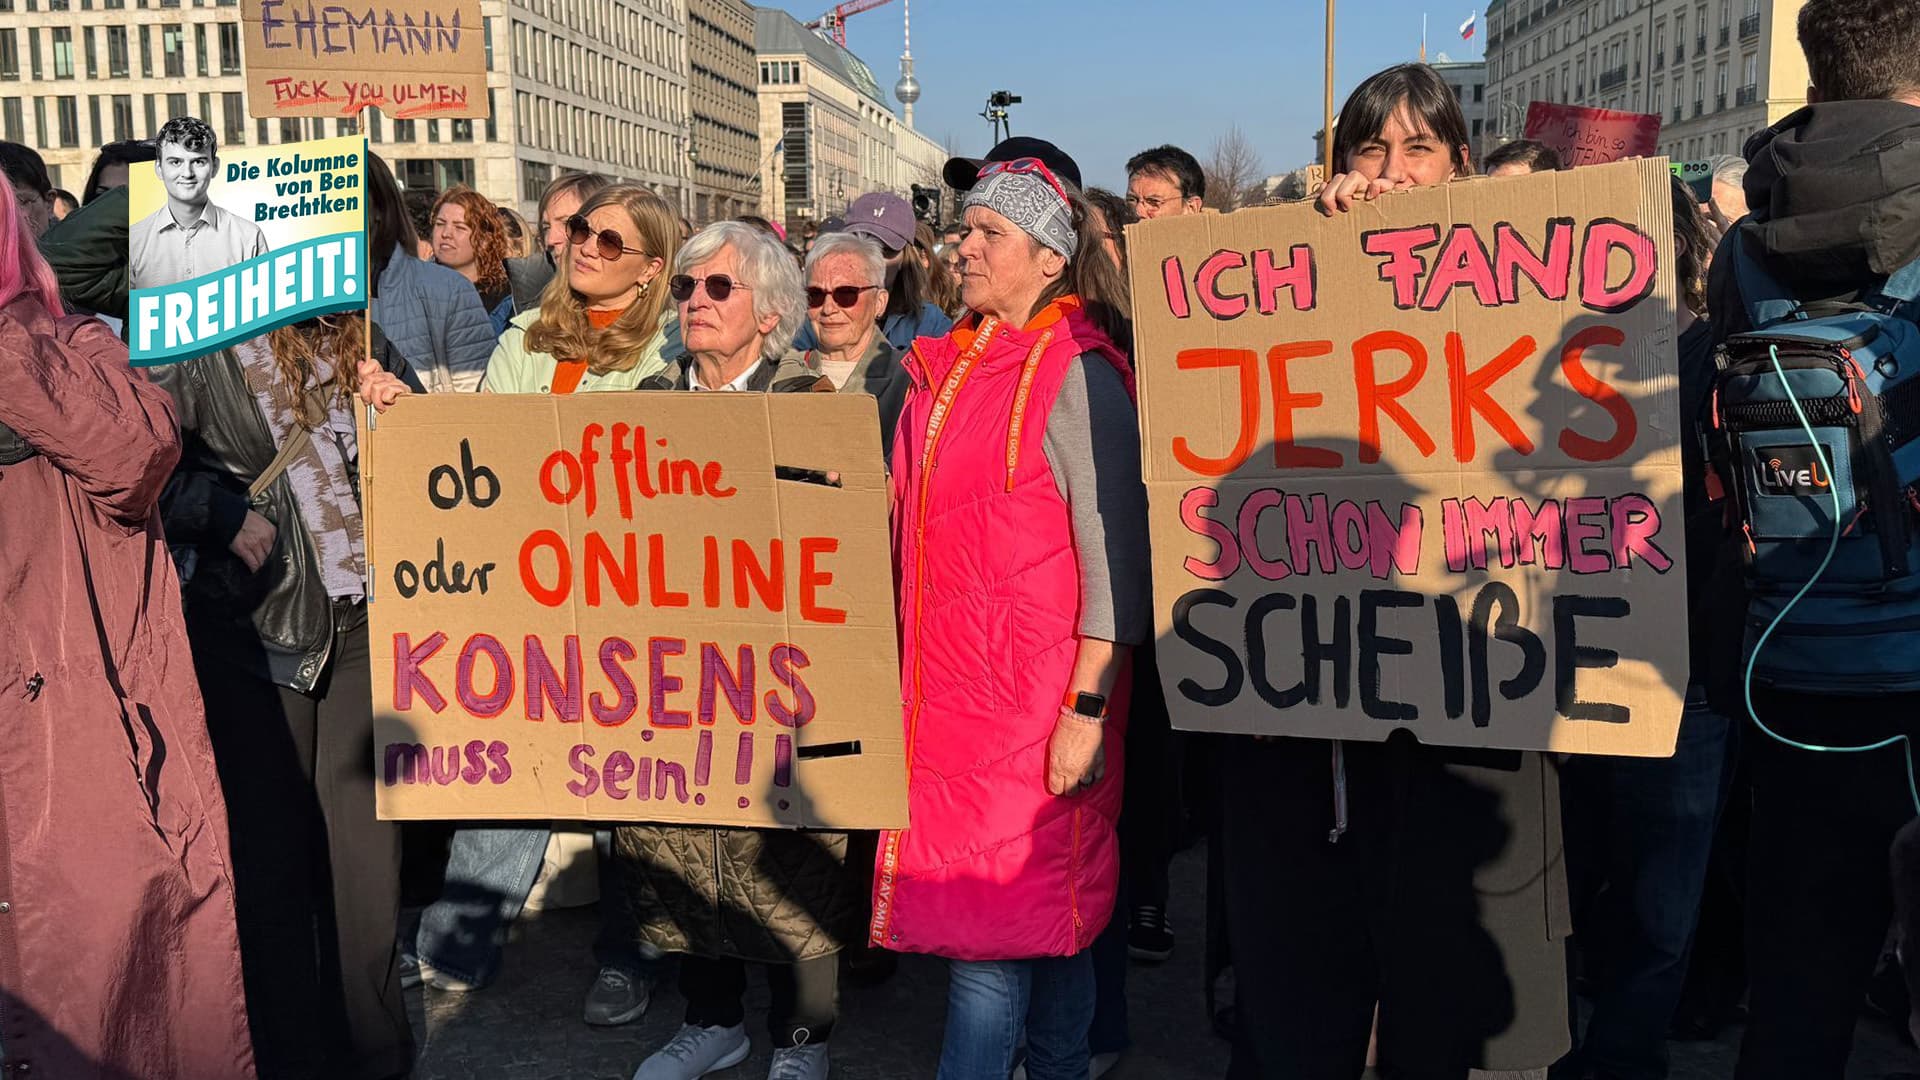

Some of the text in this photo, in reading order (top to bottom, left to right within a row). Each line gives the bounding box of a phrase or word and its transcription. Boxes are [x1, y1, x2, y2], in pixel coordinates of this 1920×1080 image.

[261, 0, 461, 59] EHEMANN
[266, 77, 468, 105] FUCK YOU ULMEN
[1586, 124, 1608, 149] bin
[1161, 216, 1657, 321] ICH FAND
[974, 318, 999, 353] SMILE
[1172, 324, 1638, 477] JERKS
[427, 421, 738, 522] ob offline
[1179, 486, 1673, 581] SCHON IMMER
[393, 528, 848, 624] oder ONLINE
[391, 630, 817, 730] KONSENS
[383, 738, 513, 787] muss
[871, 899, 889, 937] SMILE
